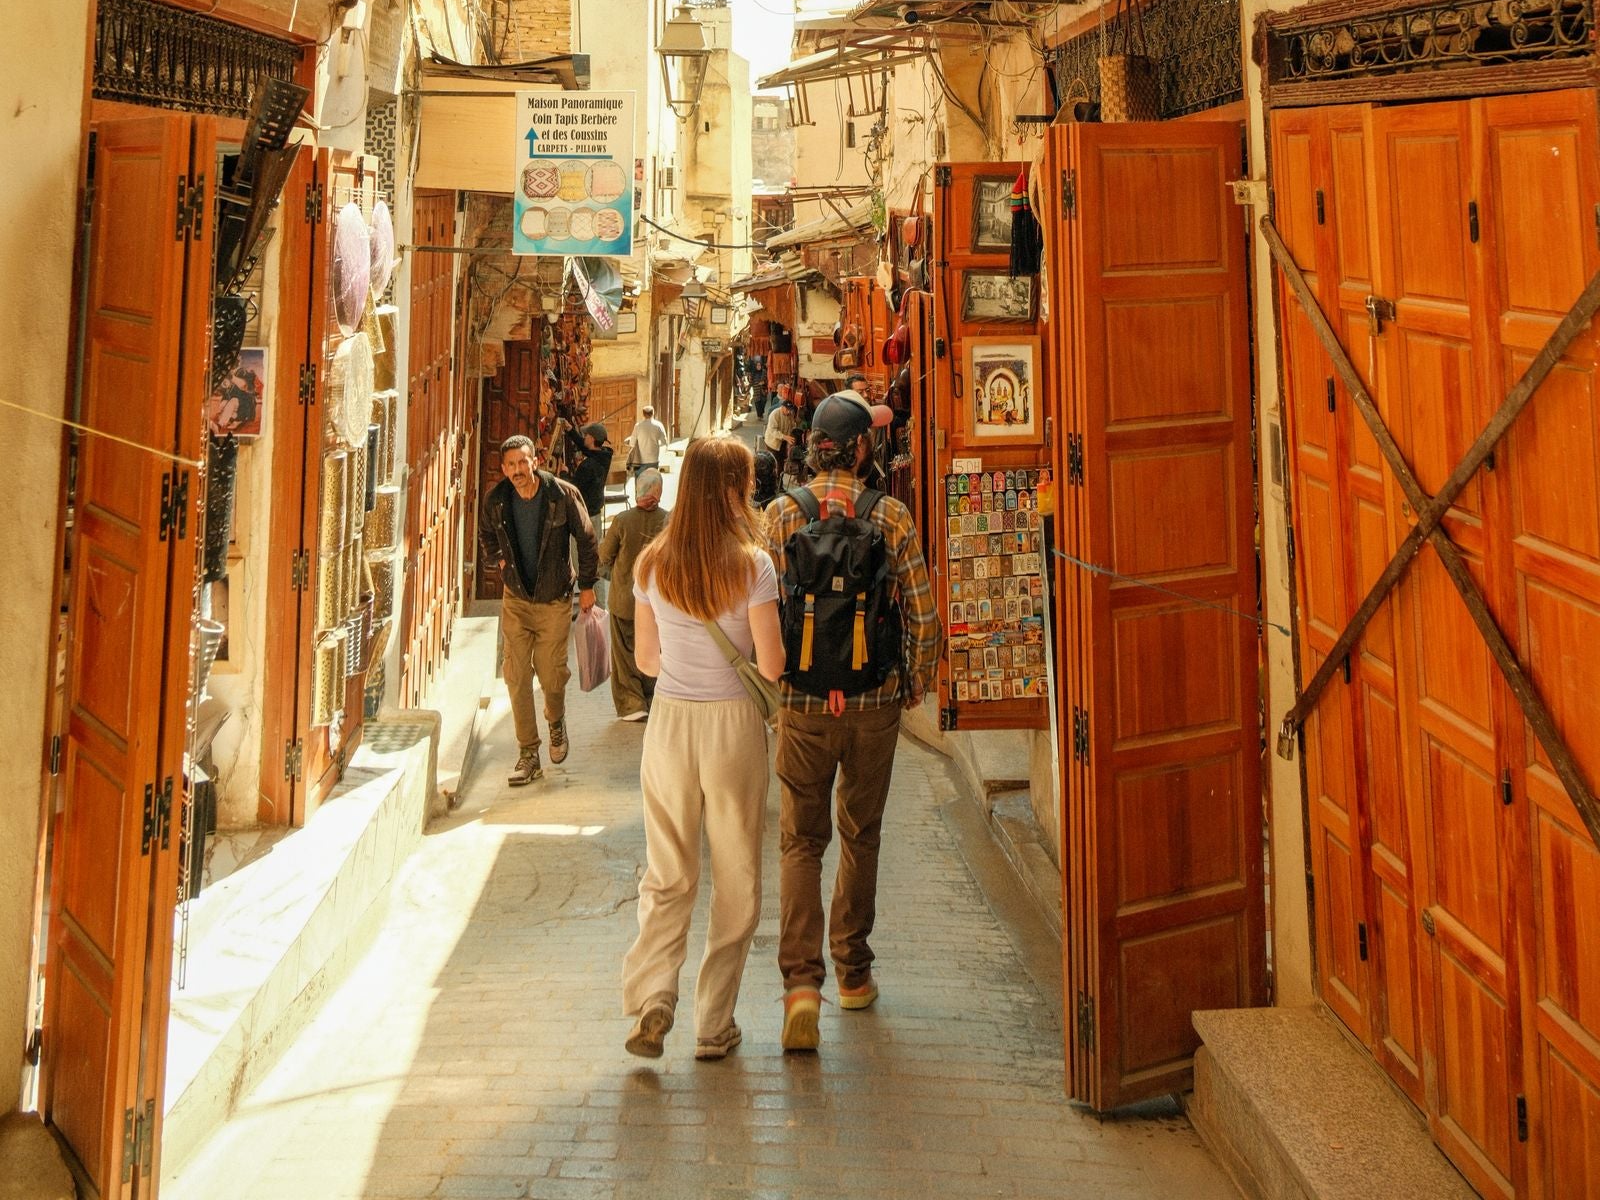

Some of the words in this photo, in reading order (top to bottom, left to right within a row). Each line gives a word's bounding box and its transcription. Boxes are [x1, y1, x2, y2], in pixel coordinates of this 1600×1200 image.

[528, 98, 558, 108] Maison
[561, 98, 623, 110] Panoramique
[532, 114, 552, 124] Coin
[556, 114, 578, 126] Tapis
[581, 114, 618, 124] Berbère
[542, 130, 550, 140] et
[553, 130, 568, 140] des
[570, 130, 608, 140] Coussins
[538, 144, 568, 152] CARPETS
[576, 144, 606, 152] PILLOWS
[956, 460, 964, 472] 5
[966, 460, 980, 472] DH
